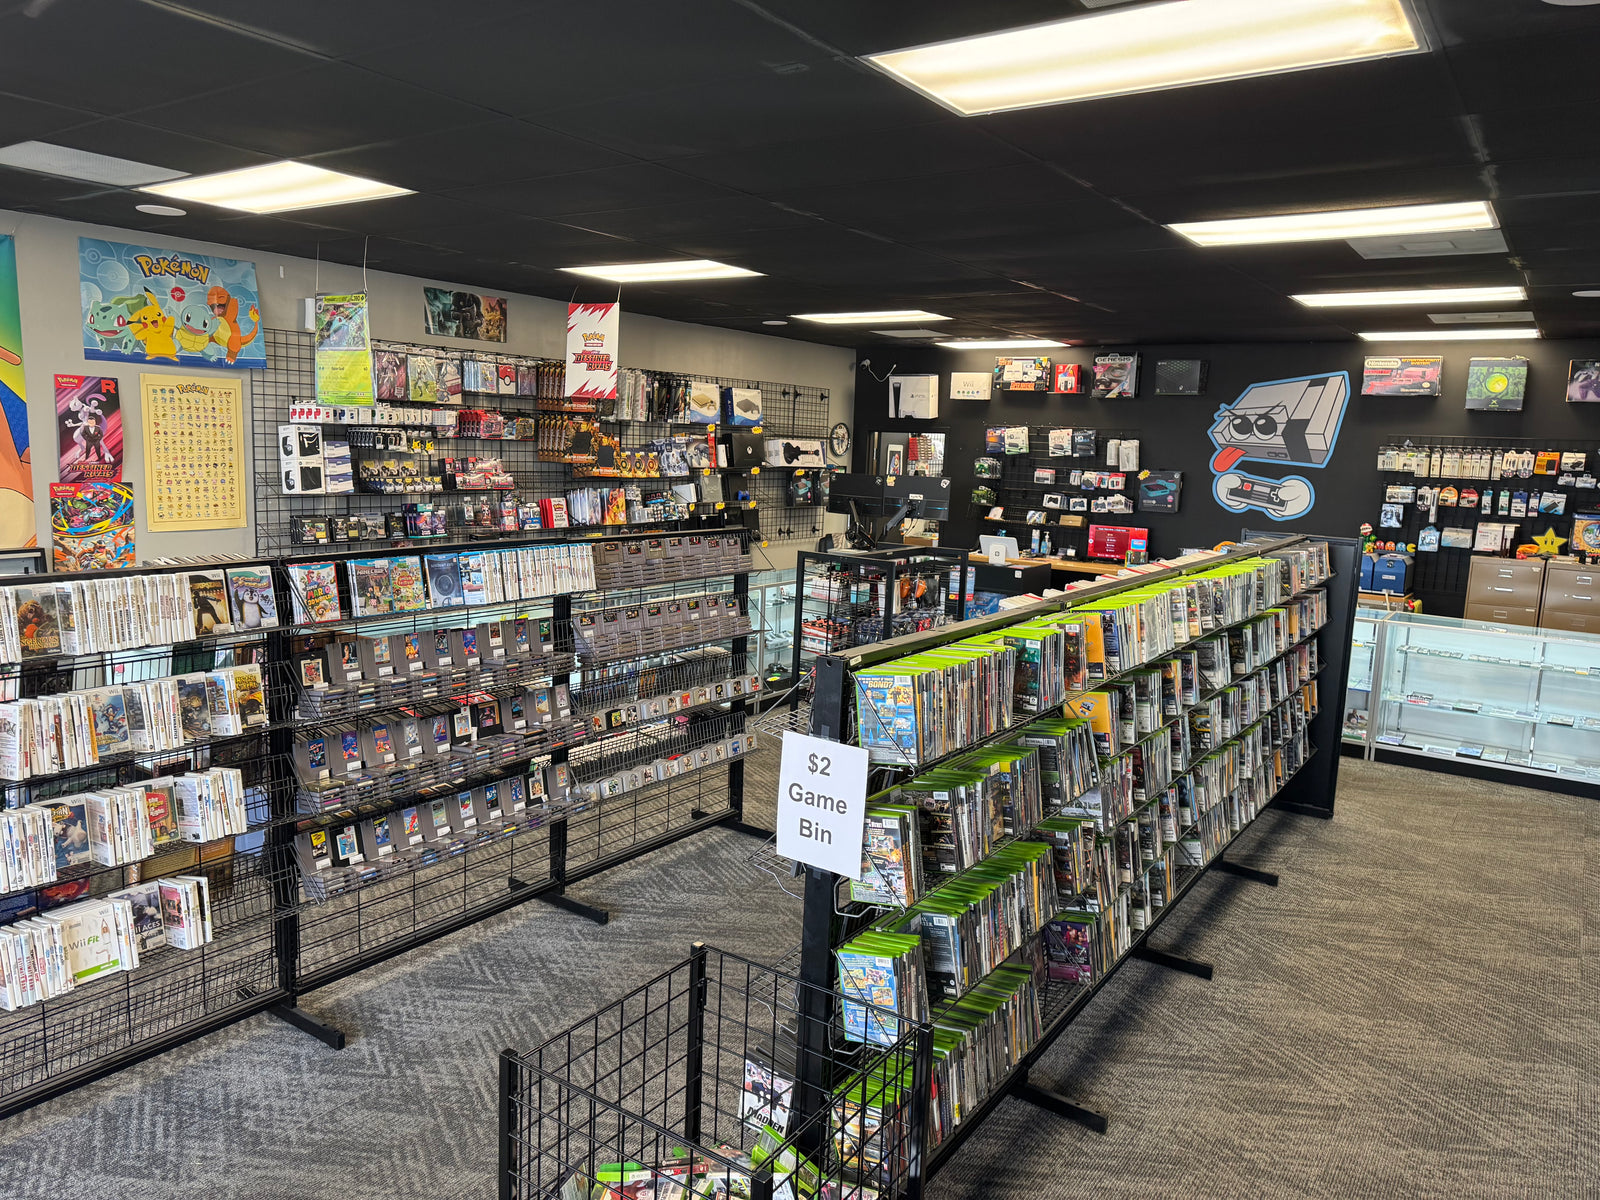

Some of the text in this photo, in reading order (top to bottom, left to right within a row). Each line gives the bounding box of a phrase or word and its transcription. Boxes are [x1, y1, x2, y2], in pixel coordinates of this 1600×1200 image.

[101, 379, 116, 393] R
[307, 586, 331, 599] MARIO
[868, 680, 893, 689] BOND?
[808, 753, 831, 777] $2
[788, 783, 848, 815] Game
[799, 817, 832, 845] Bin
[142, 921, 161, 932] ACES
[69, 935, 100, 950] Wii Fit
